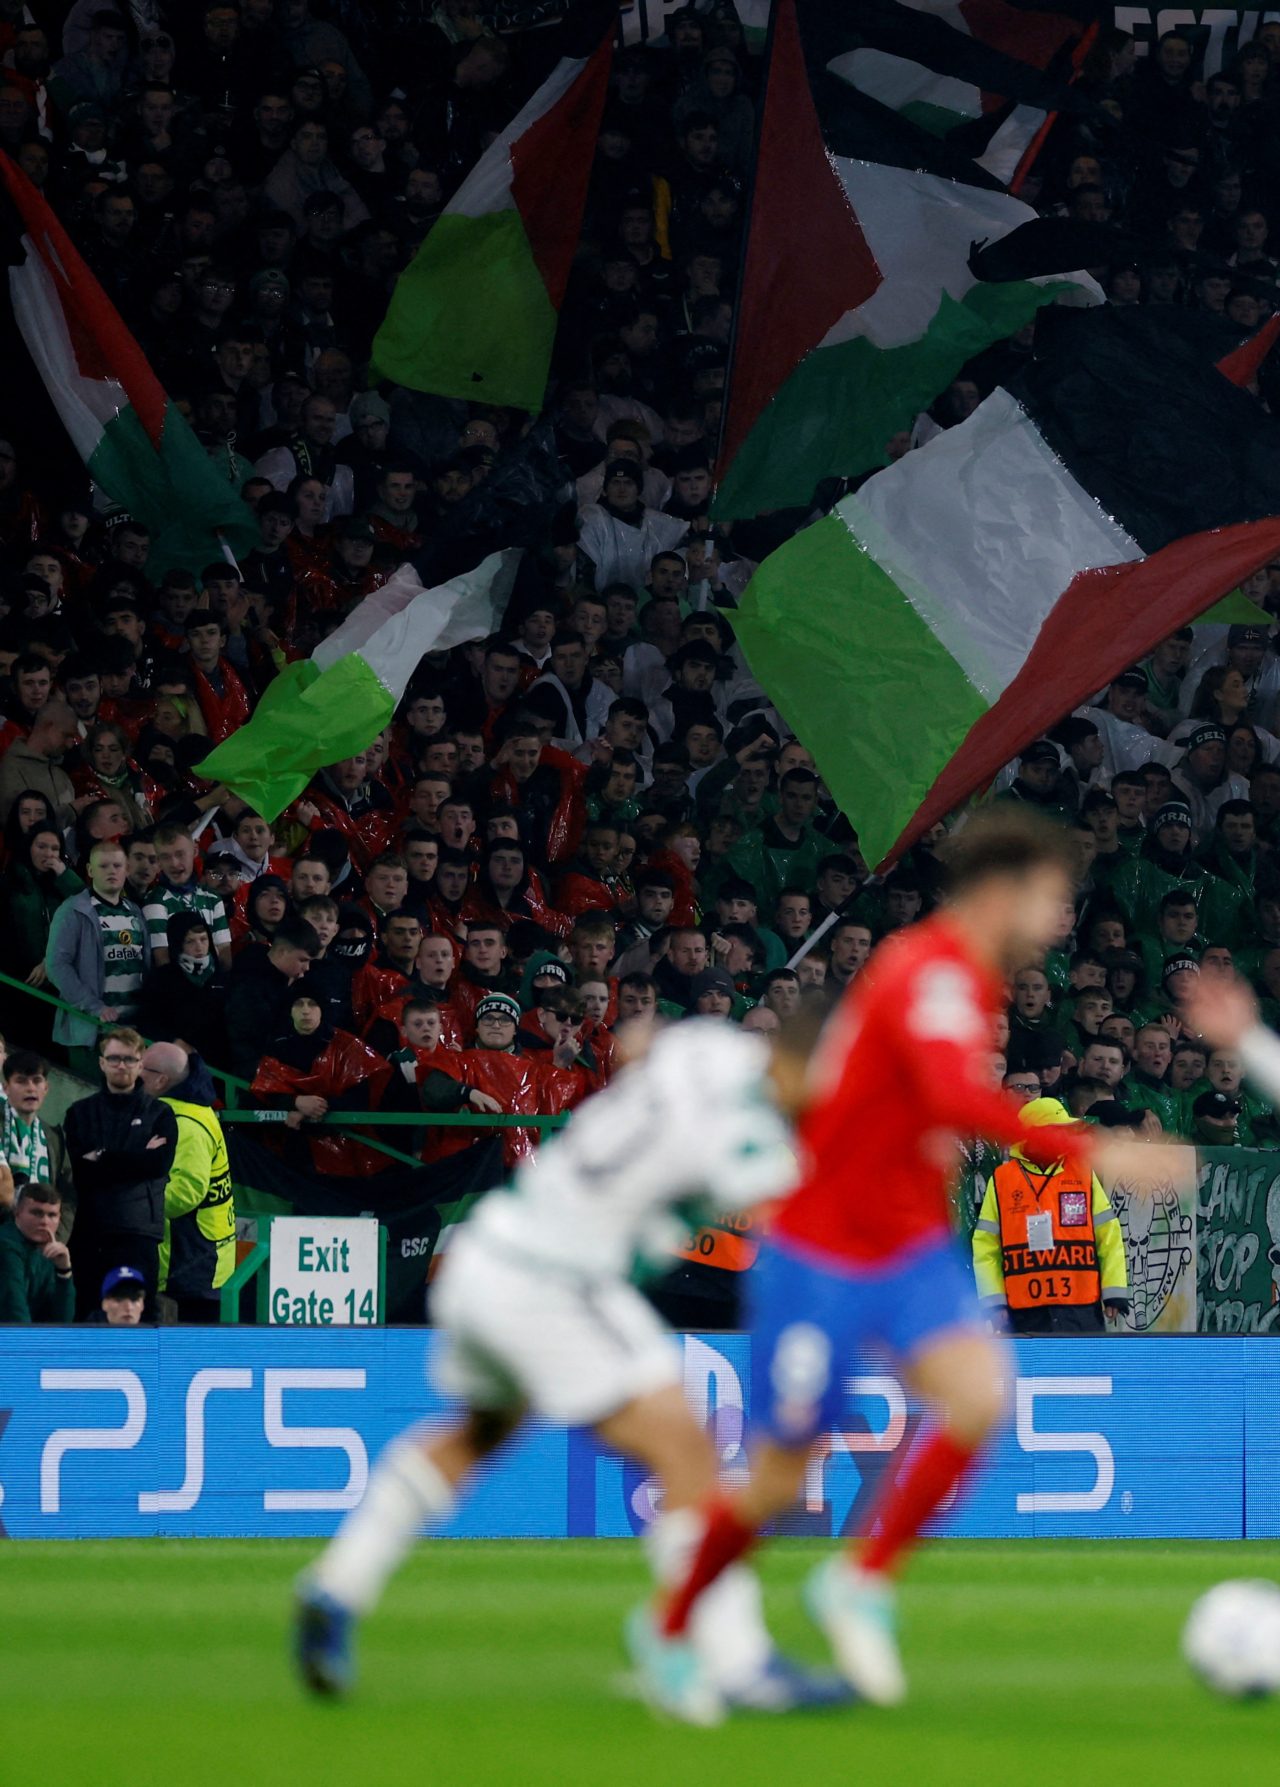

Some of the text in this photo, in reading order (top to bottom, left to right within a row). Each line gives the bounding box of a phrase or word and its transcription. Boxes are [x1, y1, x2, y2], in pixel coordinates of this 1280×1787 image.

[298, 1236, 350, 1273] Exit
[400, 1237, 430, 1259] CSC
[271, 1287, 375, 1325] Gate 14
[1028, 1277, 1072, 1299] 013
[1151, 1267, 1174, 1312] CREW
[40, 1368, 369, 1513] PS5
